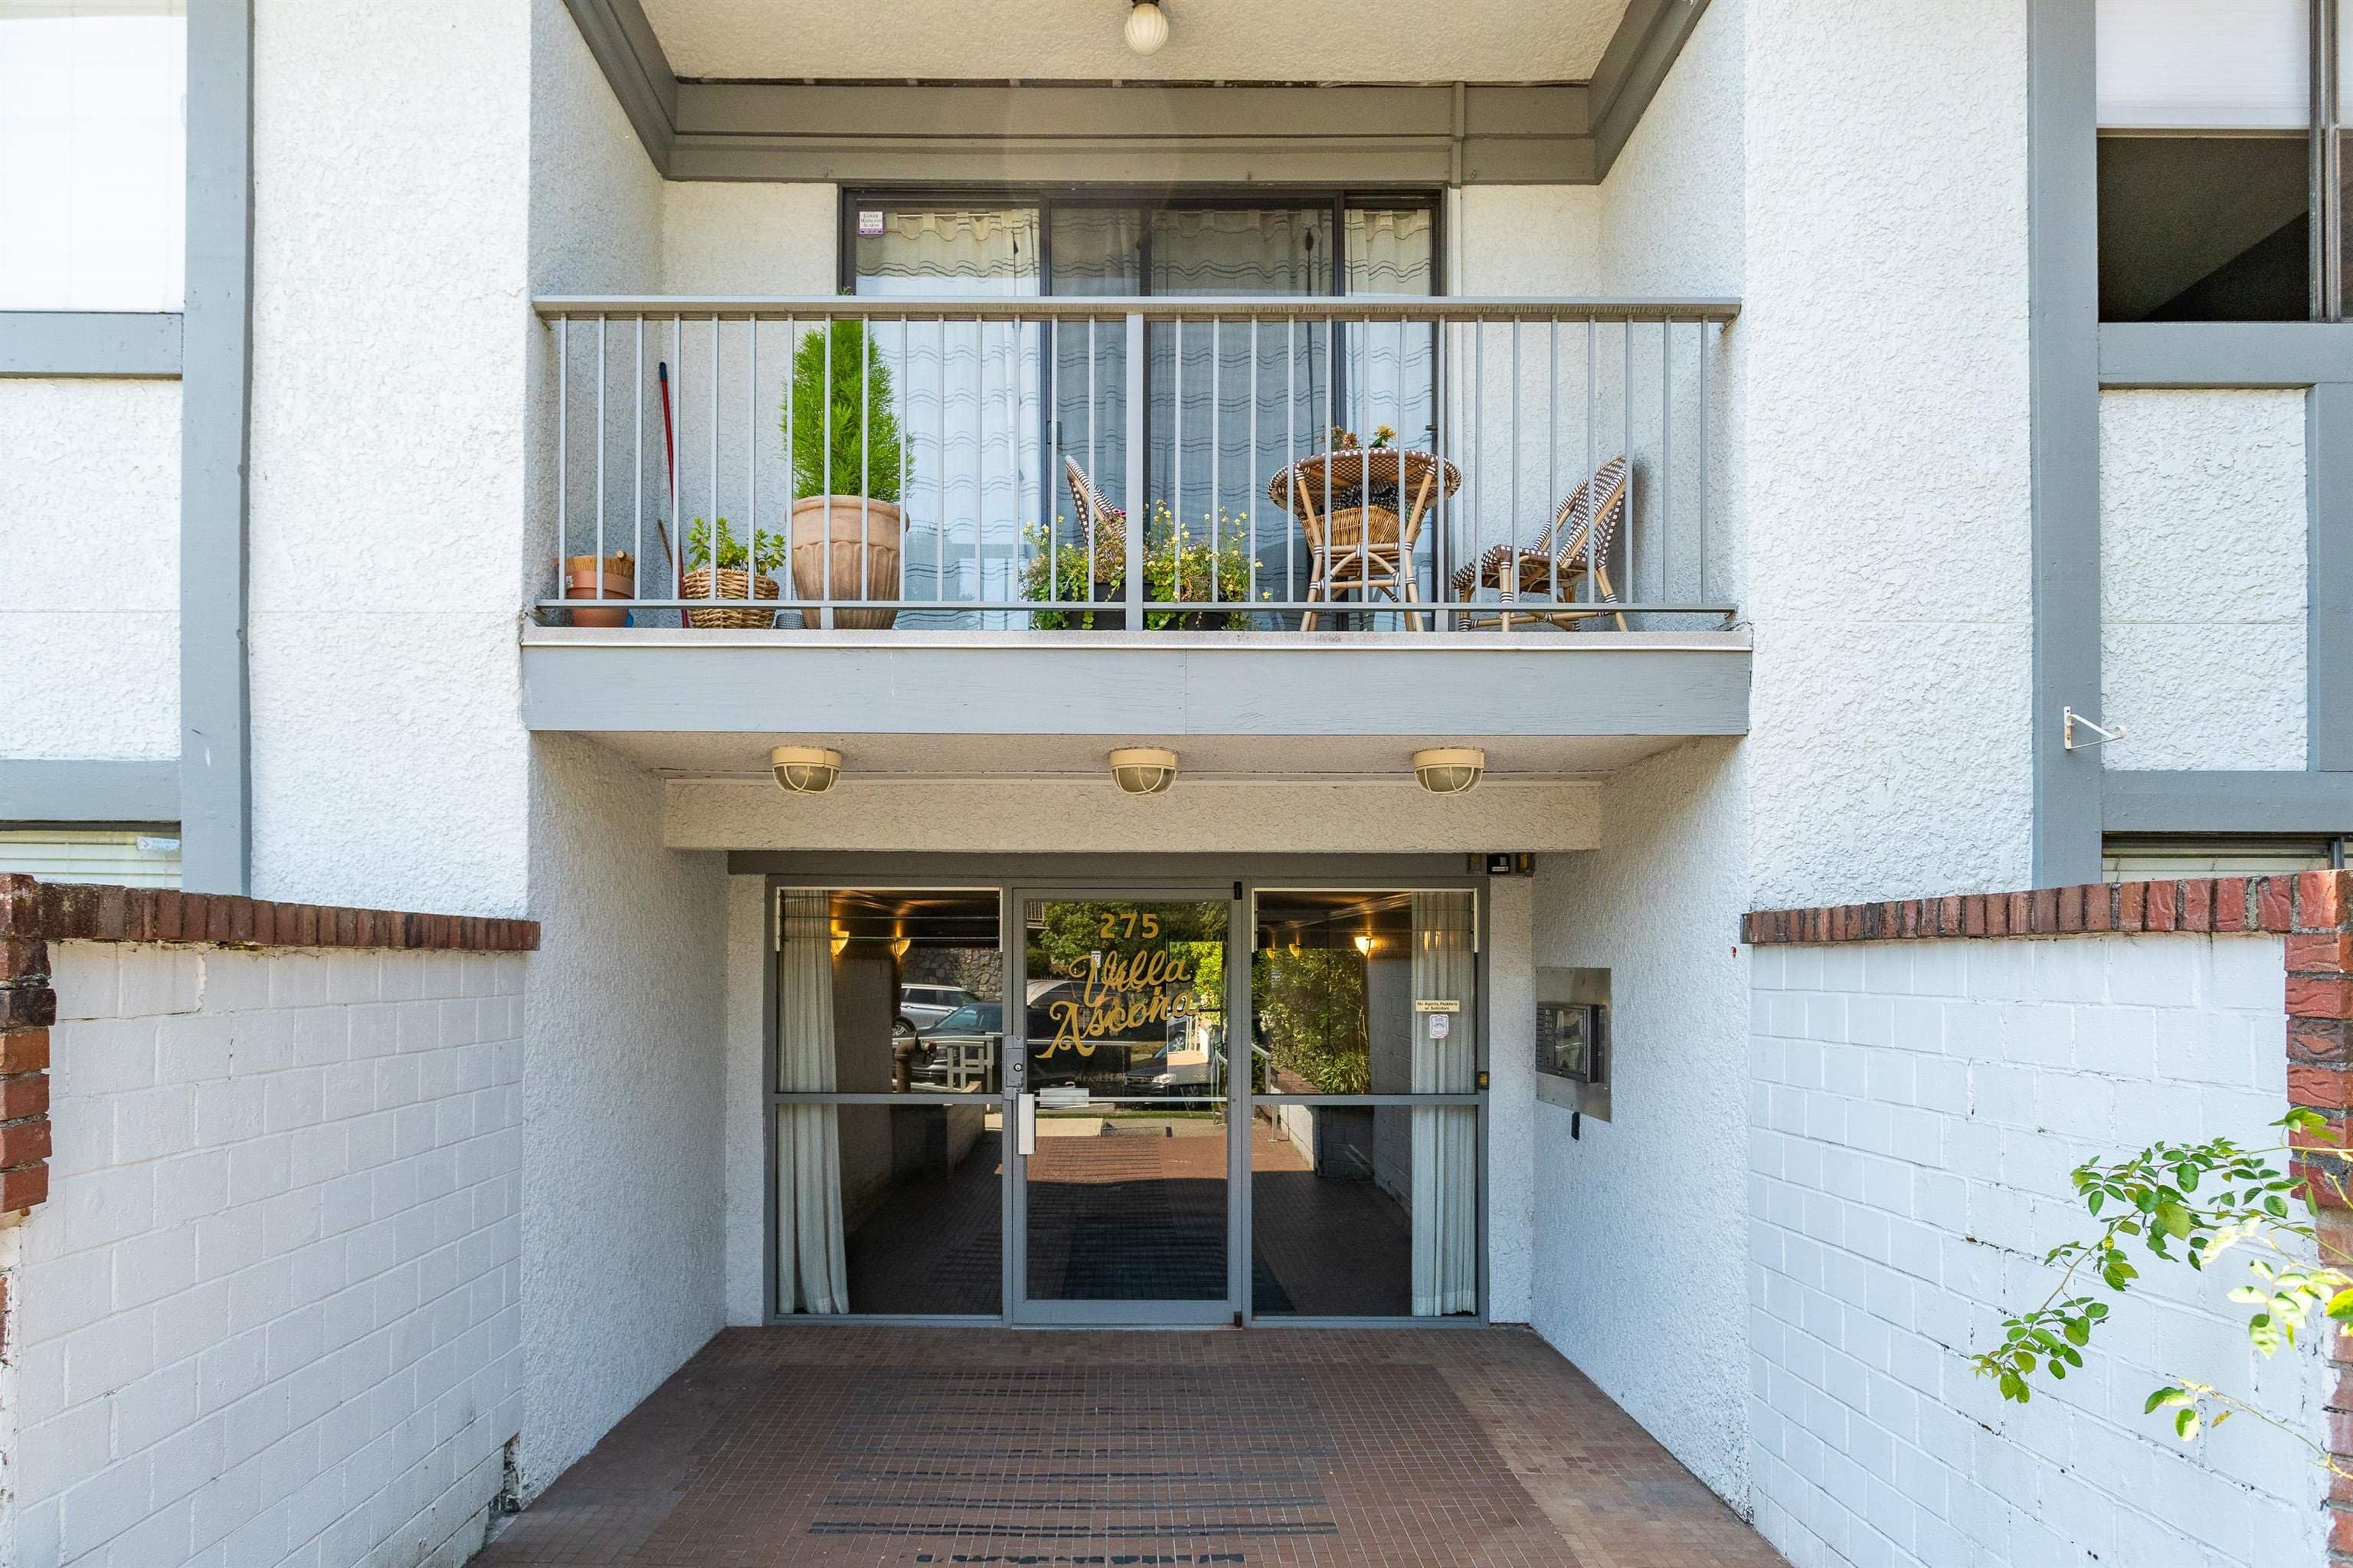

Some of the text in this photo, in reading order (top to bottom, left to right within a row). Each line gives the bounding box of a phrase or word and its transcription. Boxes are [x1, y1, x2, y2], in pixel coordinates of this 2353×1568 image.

[1100, 913, 1159, 938] 275
[1069, 950, 1192, 1007] Villa
[1035, 986, 1198, 1059] Ascona
